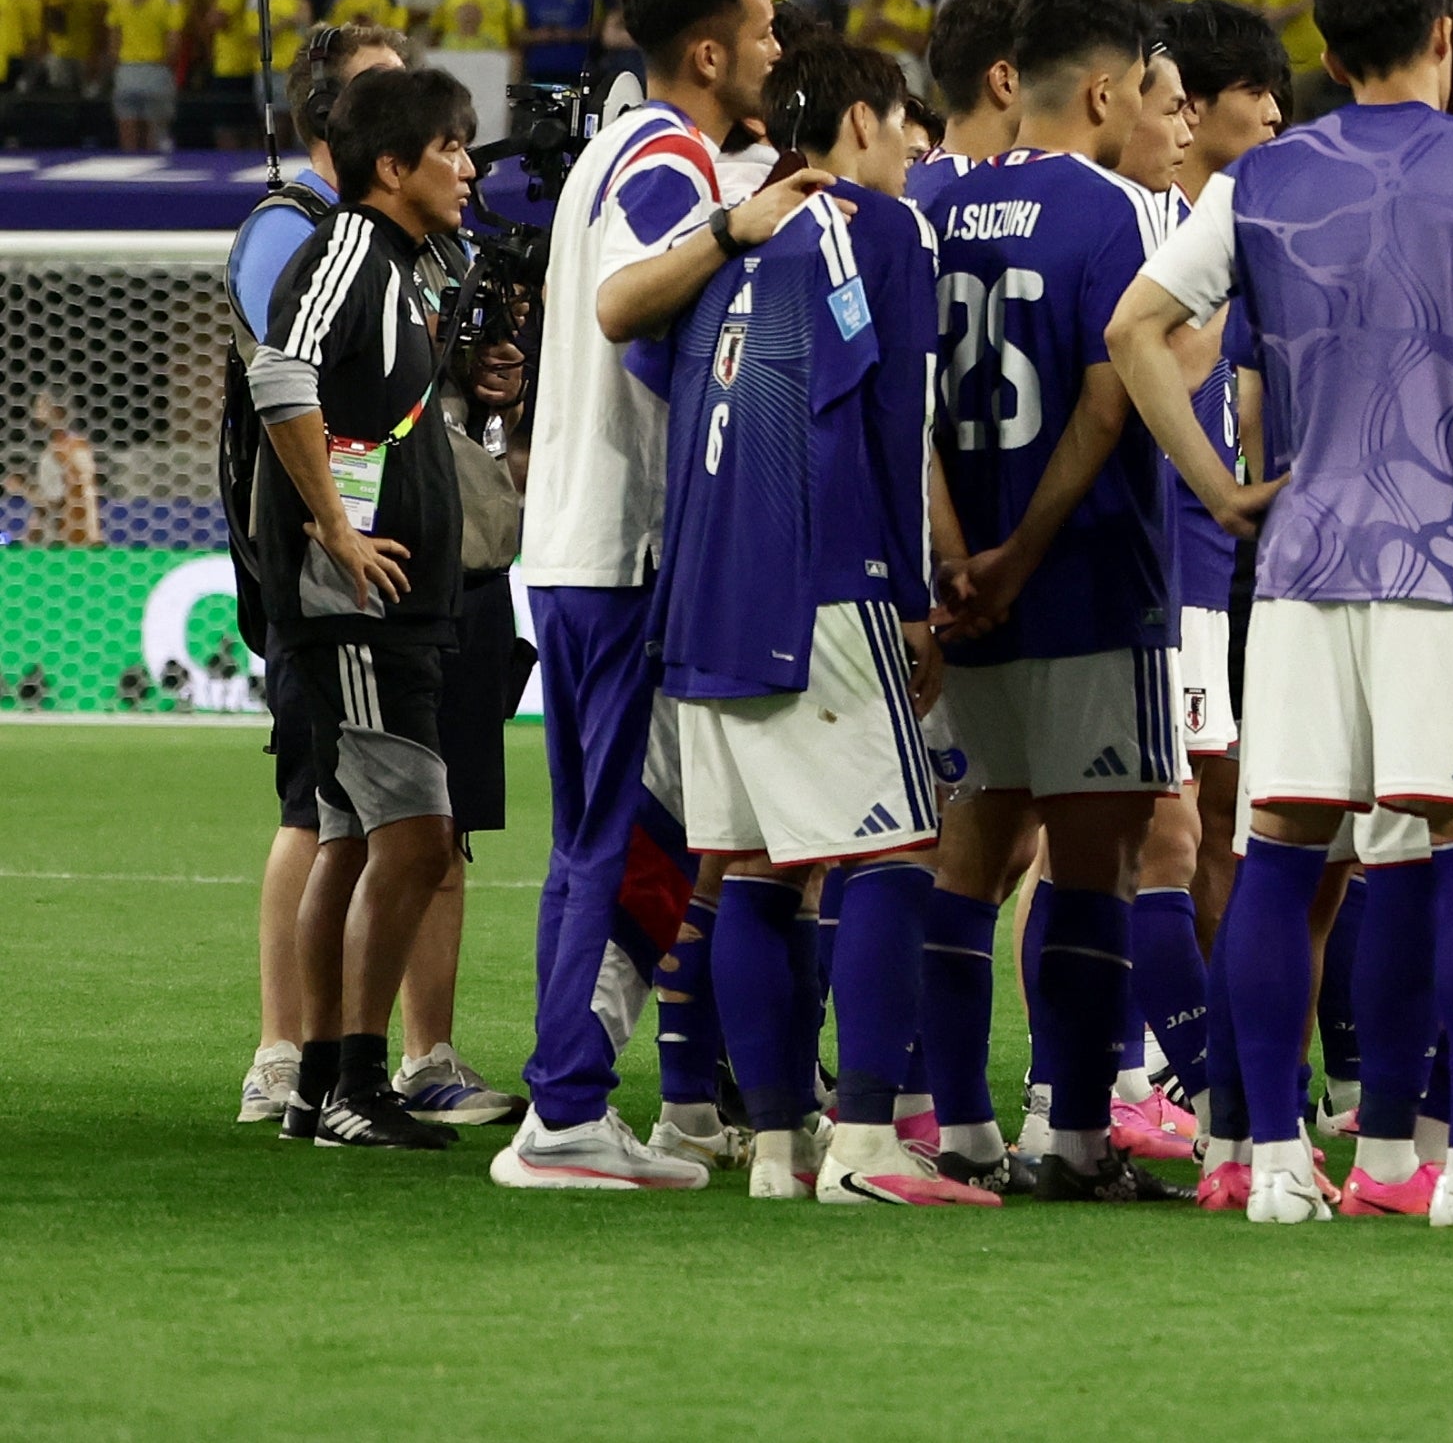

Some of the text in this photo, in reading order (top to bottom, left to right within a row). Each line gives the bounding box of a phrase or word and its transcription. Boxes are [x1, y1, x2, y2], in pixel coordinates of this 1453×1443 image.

[943, 199, 1042, 240] J.SUZUKI
[936, 267, 1044, 451] 25
[705, 402, 730, 476] 6
